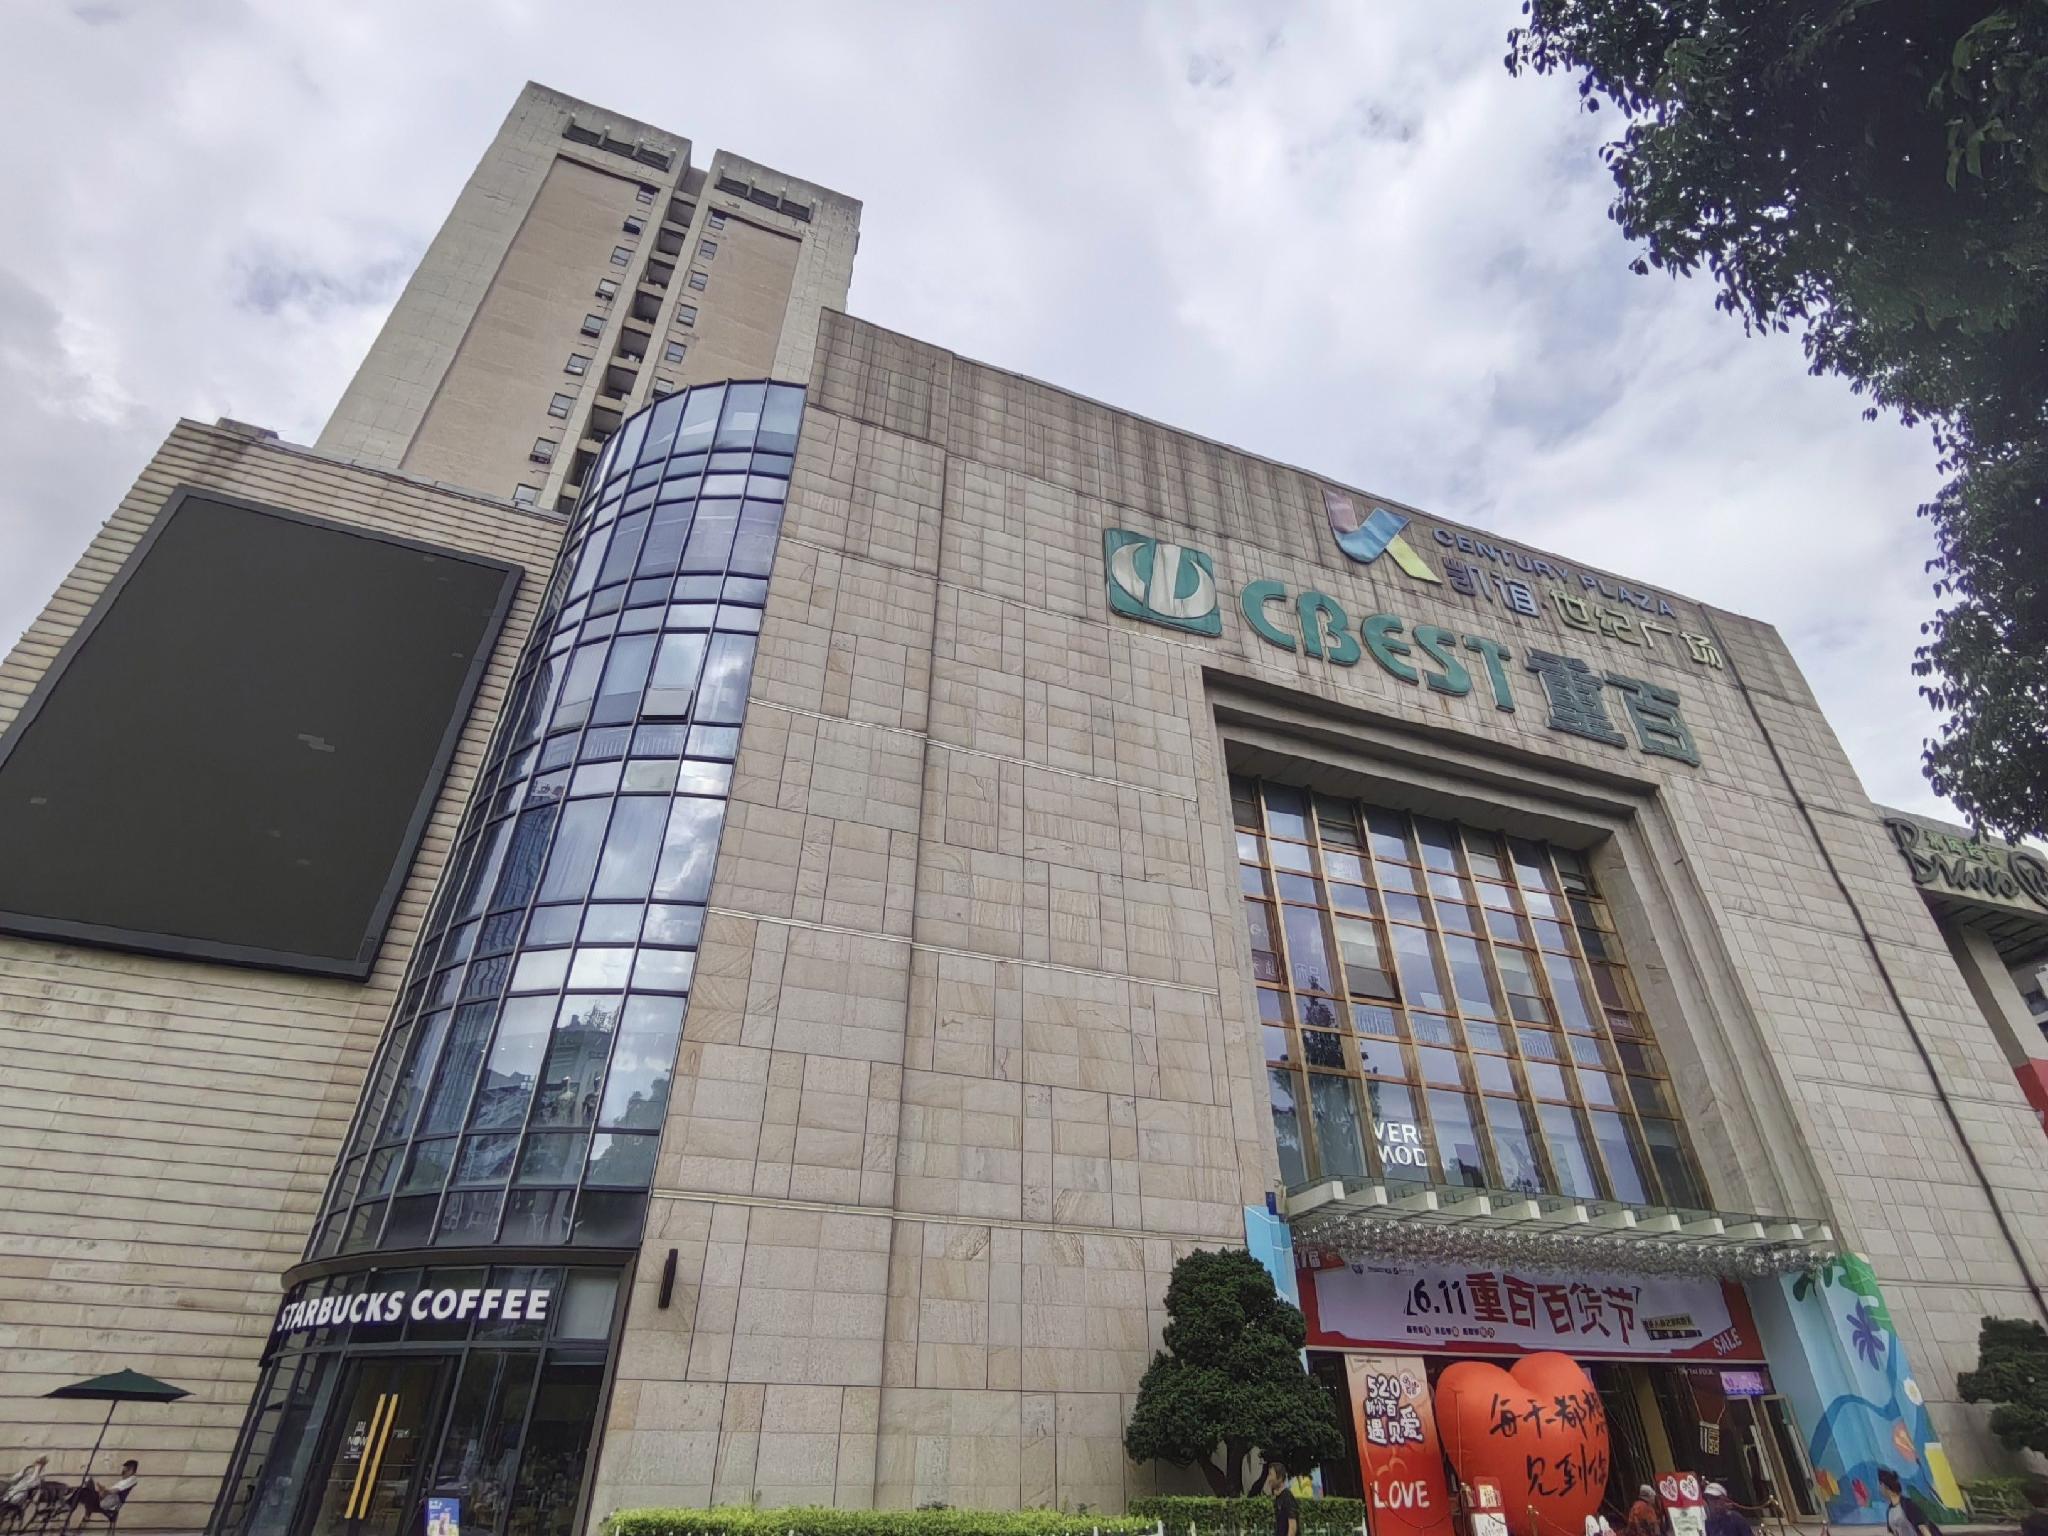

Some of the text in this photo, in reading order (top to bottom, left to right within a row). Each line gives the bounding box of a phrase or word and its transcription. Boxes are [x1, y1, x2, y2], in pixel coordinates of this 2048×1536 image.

[1432, 527, 1677, 619] CENTURY PLAZA
[1239, 579, 1699, 766] CBEST 重百
[1373, 1122, 1422, 1144] VER
[276, 1288, 551, 1332] STARBUCKS COFFEE
[1711, 1327, 1743, 1356] SALE
[1367, 1374, 1400, 1399] 520
[1373, 1479, 1431, 1509] LOVE
